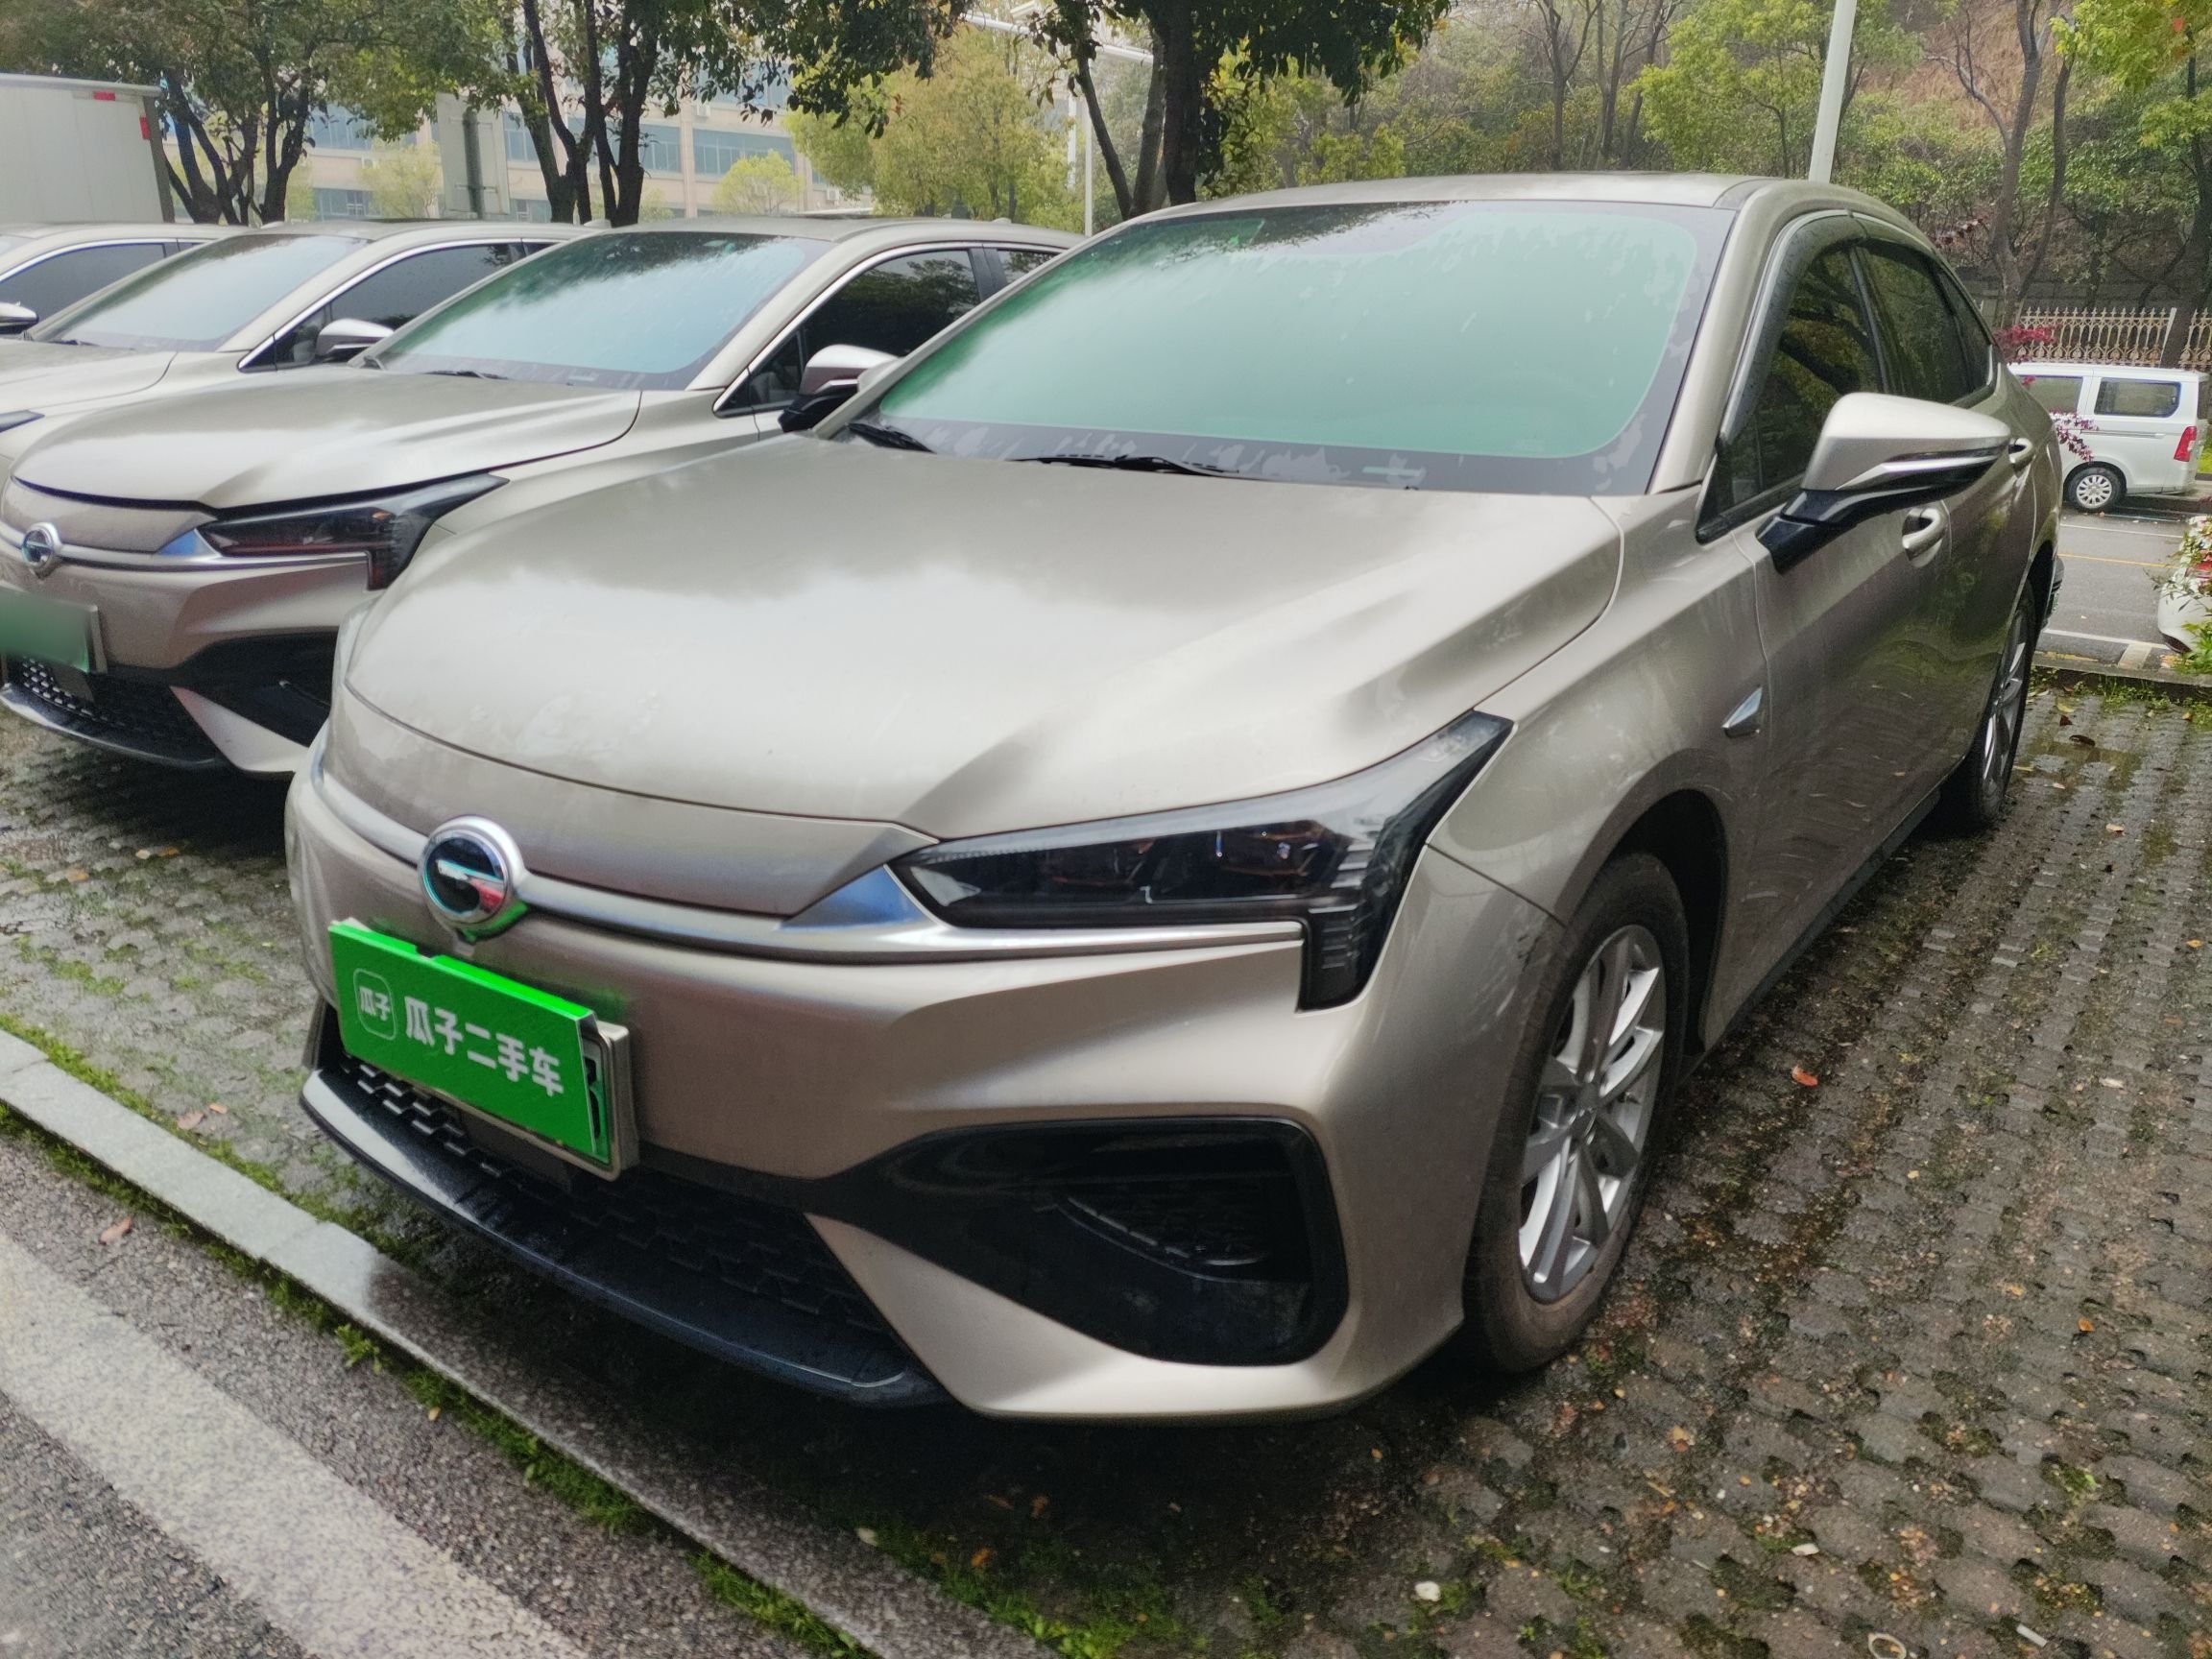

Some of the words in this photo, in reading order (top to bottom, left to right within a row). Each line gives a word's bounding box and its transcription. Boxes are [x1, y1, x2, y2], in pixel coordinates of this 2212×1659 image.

[359, 986, 391, 1021] 瓜子
[404, 996, 564, 1096] 瓜子二手车
